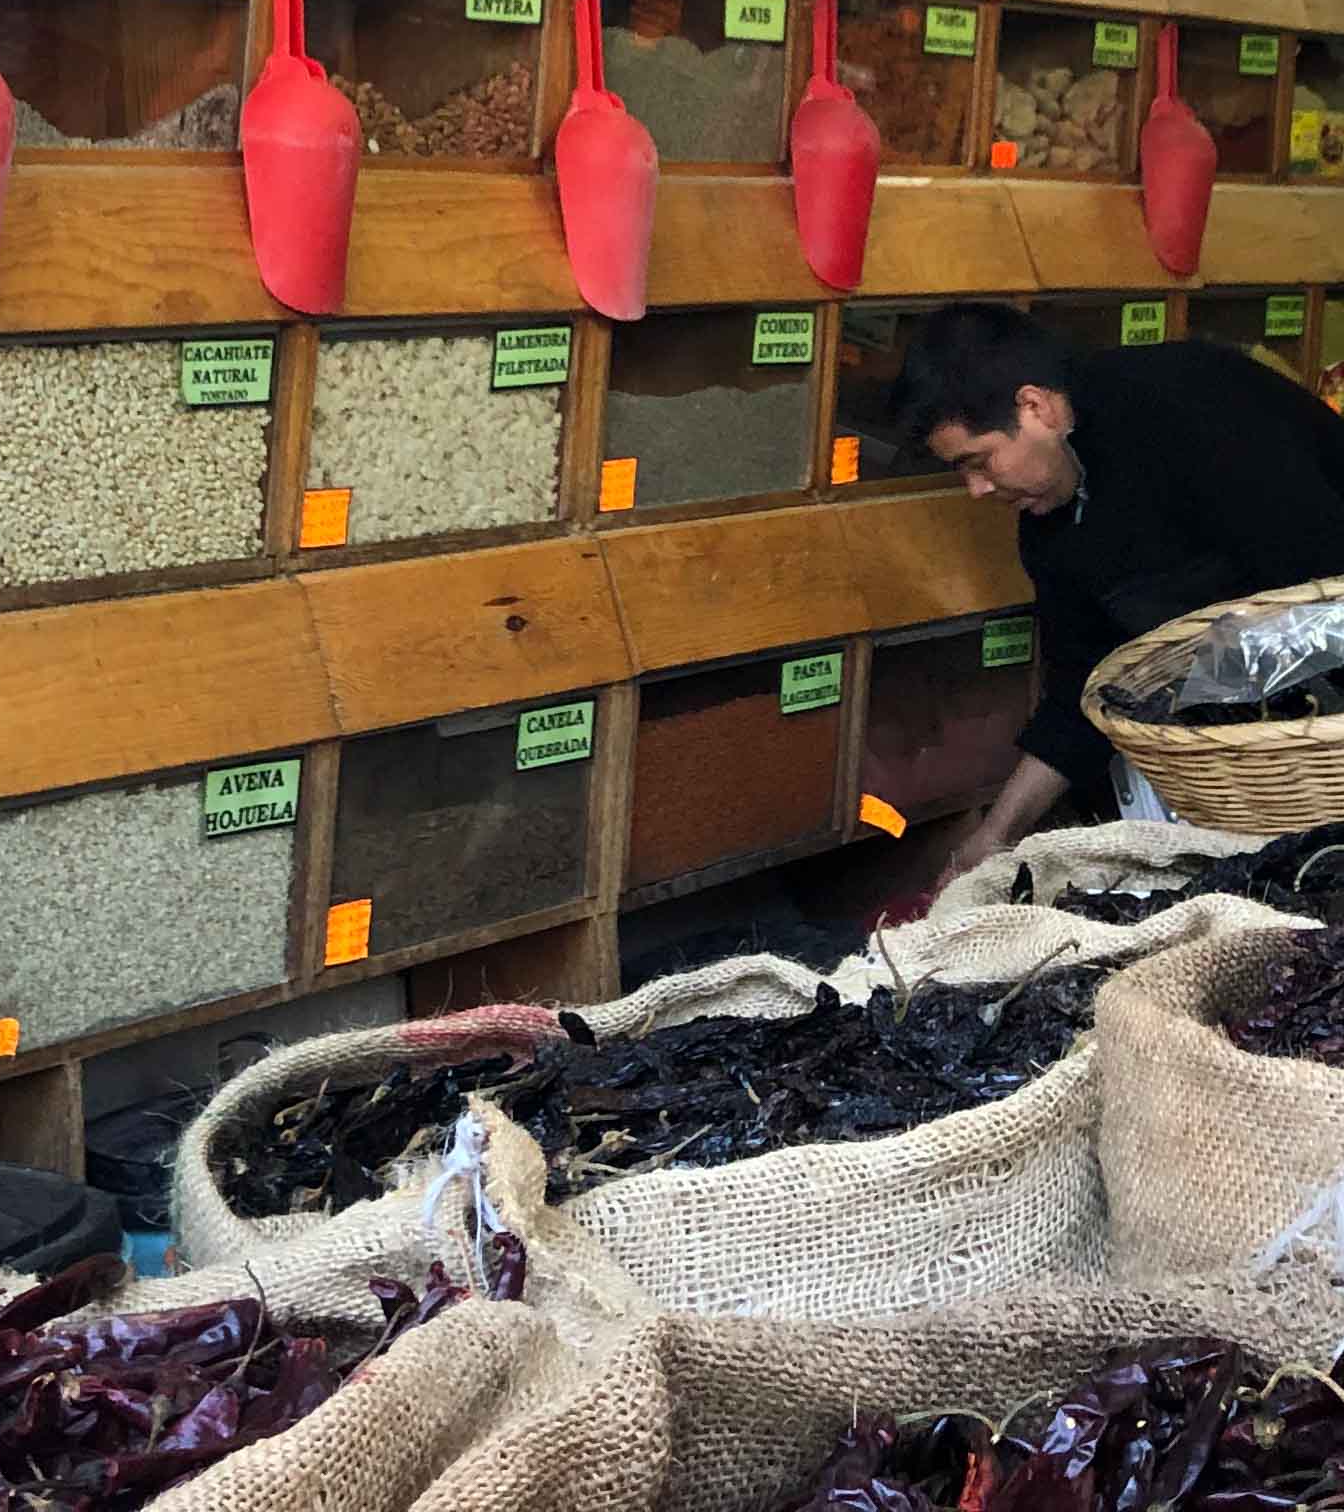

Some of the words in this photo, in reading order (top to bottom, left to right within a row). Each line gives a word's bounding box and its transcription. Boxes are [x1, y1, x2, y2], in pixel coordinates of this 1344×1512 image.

[739, 6, 772, 25] ANIS
[759, 317, 811, 336] COMINO
[496, 330, 569, 352] ALMENDRA
[757, 341, 810, 361] ENTERO
[183, 343, 273, 363] CACAHUATE
[191, 366, 260, 386] NATURAL
[494, 354, 569, 379] FILETEADA
[525, 707, 586, 736] CANELA
[516, 737, 591, 764] QUEBRADA
[218, 766, 285, 798] AVENA
[205, 800, 296, 832] HOJUELA
